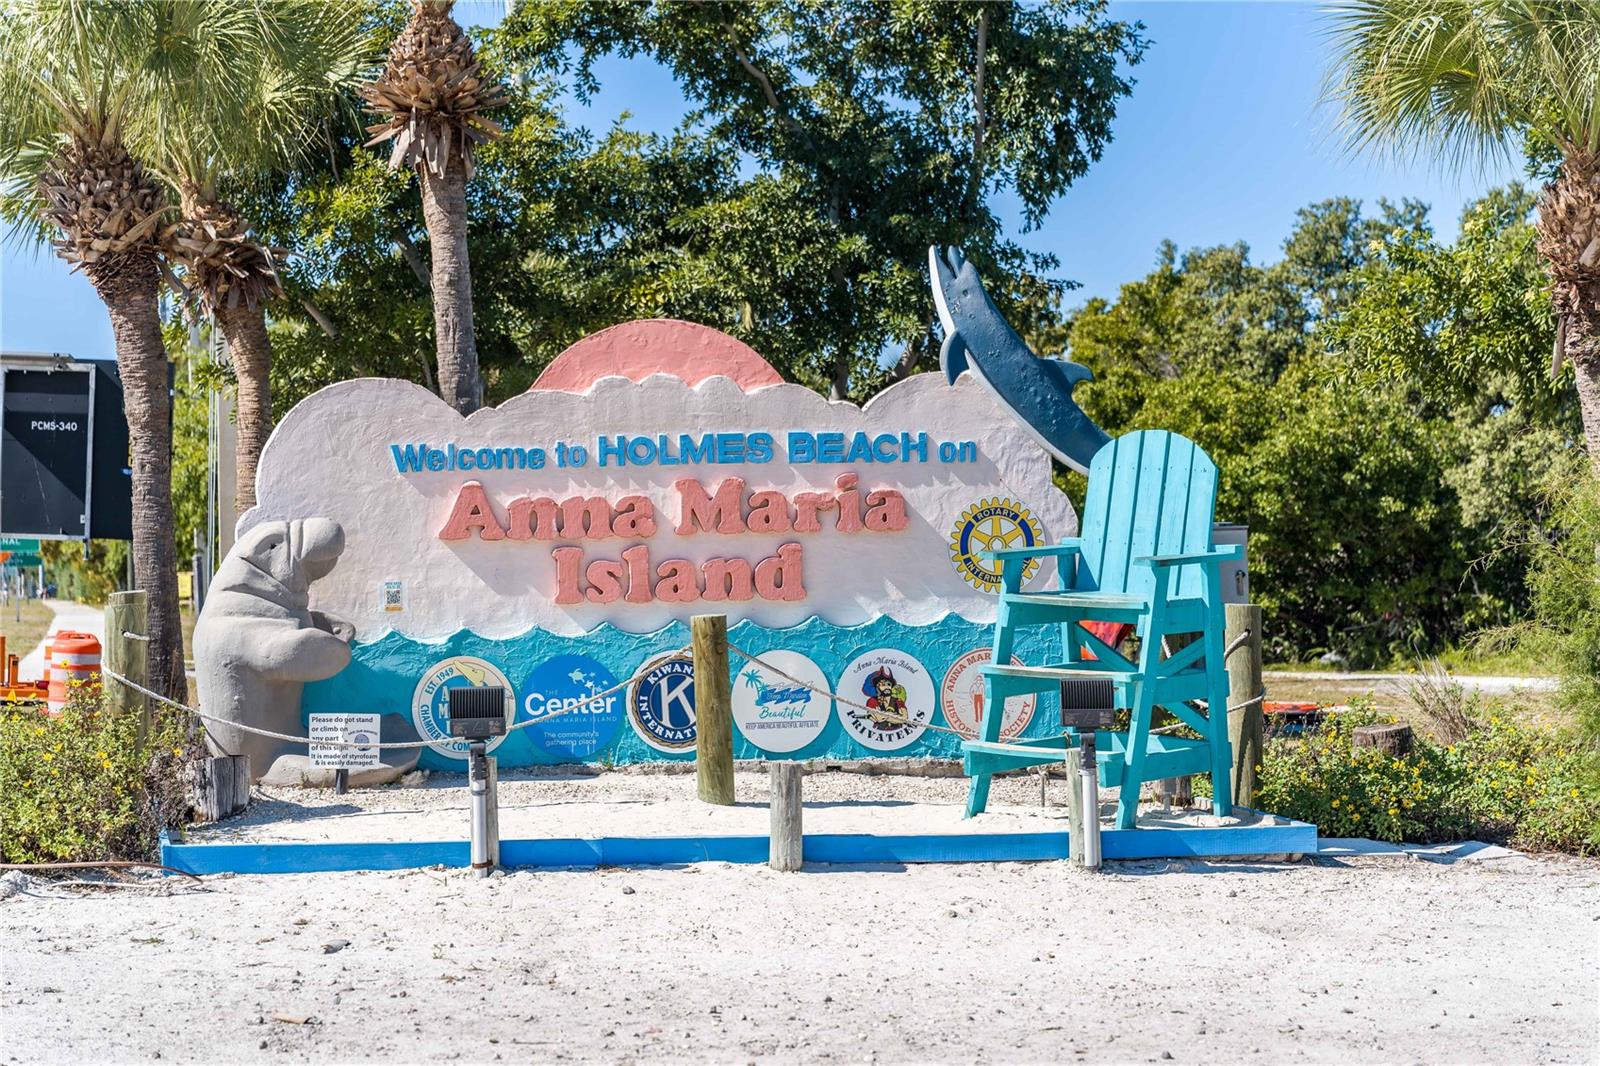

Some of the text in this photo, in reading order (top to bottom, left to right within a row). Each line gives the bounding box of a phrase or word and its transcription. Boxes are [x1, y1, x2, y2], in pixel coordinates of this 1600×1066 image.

[31, 420, 78, 431] PCMS-340
[390, 431, 978, 473] Welcome to HOLMES BEACH on
[438, 472, 910, 541] Anna Maria
[977, 507, 1015, 521] ROTARY
[551, 543, 807, 605] Island
[853, 656, 920, 674] Anna Maria Island
[425, 667, 454, 695] EST. 1949
[947, 664, 967, 693] ANNA
[525, 692, 617, 716] Center
[759, 704, 807, 720] Beautiful
[420, 704, 442, 740] CHAMBER
[545, 739, 577, 747] gathering
[557, 731, 600, 739] community's
